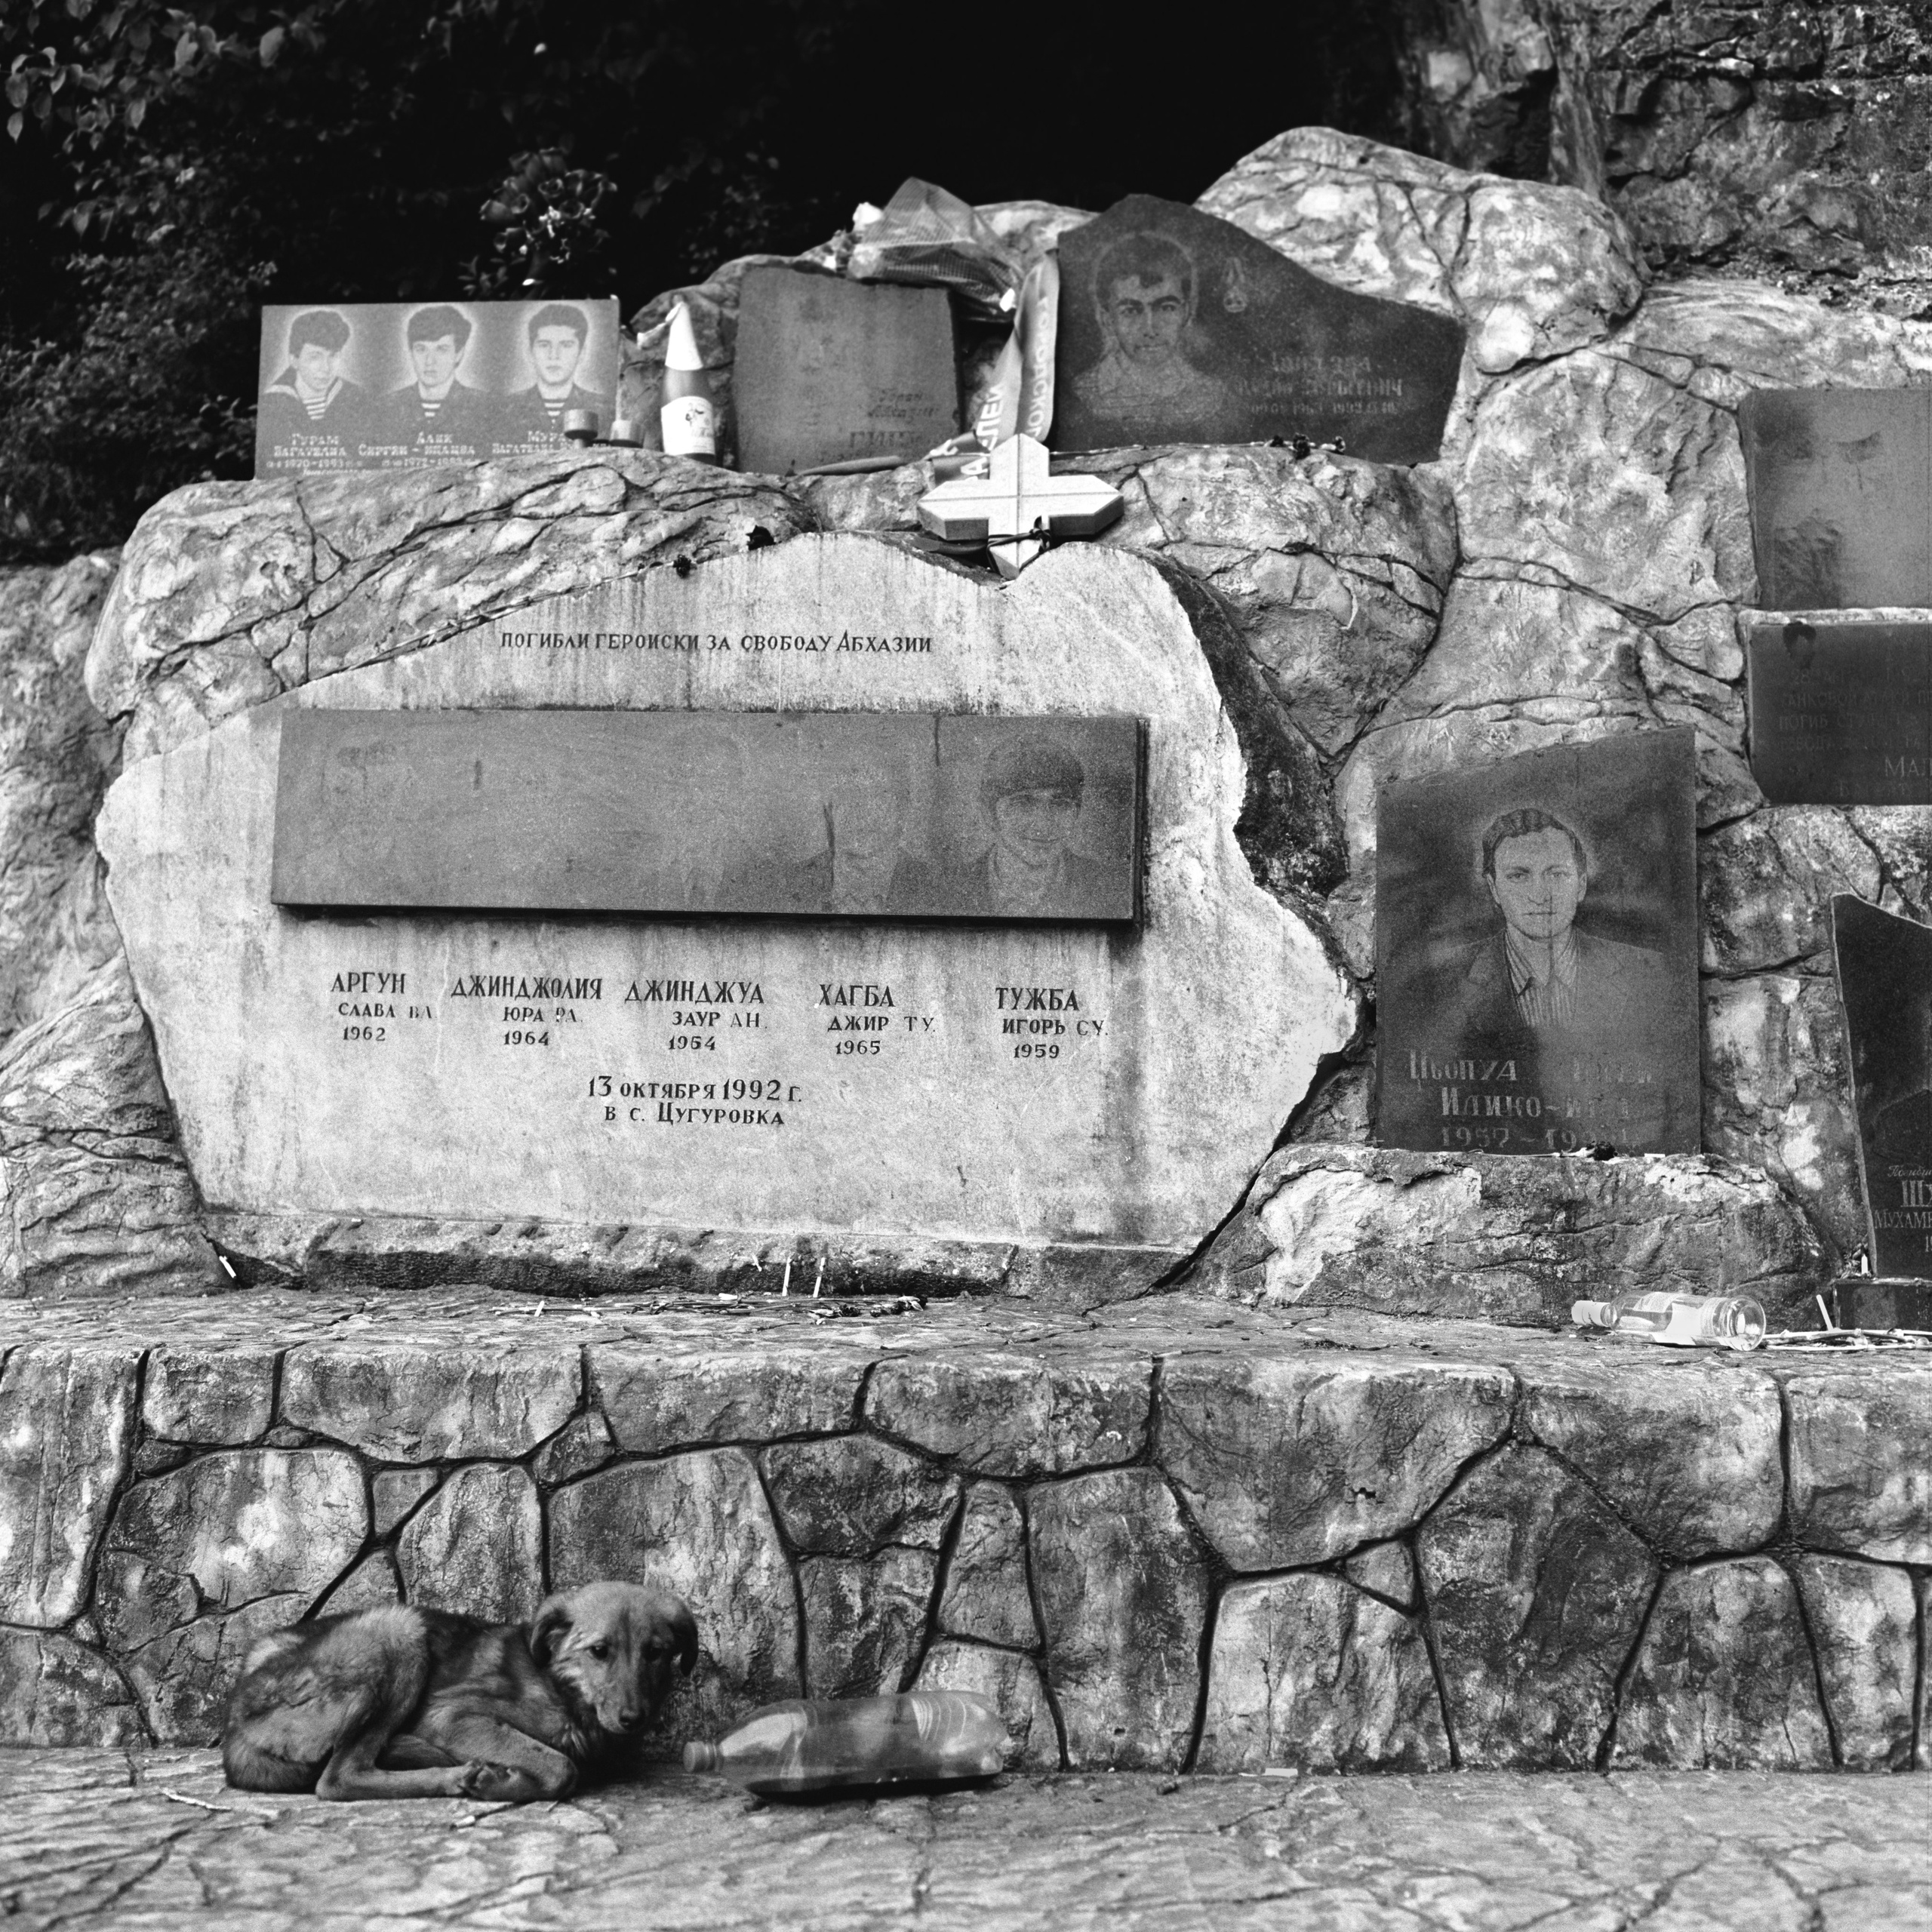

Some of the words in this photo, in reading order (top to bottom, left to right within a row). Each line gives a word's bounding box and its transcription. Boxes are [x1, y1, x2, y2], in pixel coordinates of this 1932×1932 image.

[528, 430, 571, 443] МУРА
[500, 632, 590, 649] ПОГИБЛИ
[706, 635, 731, 651] ЗА
[740, 634, 833, 653] СВОБОДУ
[835, 630, 932, 653] АБХАЗИИ
[331, 971, 406, 995] АРГУН
[451, 974, 602, 1000] ДЖИНДЖОЛИЯ
[624, 980, 764, 1004] ДЖИНДЖУА
[820, 983, 895, 1008] ХАГБА
[995, 986, 1079, 1011] ТУЖБА
[337, 1002, 395, 1018] СЛАВА
[503, 1006, 544, 1023] ЮРА
[672, 1011, 721, 1027] ЗАУР
[827, 1015, 889, 1032] ДЖИР
[1002, 1018, 1066, 1035] ИГОРЬ
[343, 1026, 386, 1041] 1962
[504, 1030, 549, 1047] 1964
[669, 1035, 715, 1051] 1954
[835, 1040, 881, 1056] 1965
[1014, 1043, 1060, 1060] 1959
[589, 1075, 612, 1097] 13
[620, 1082, 716, 1100] ОКТЯБРЯ
[722, 1078, 781, 1101] 1992
[657, 1102, 785, 1126] ЦУГУРОВКА
